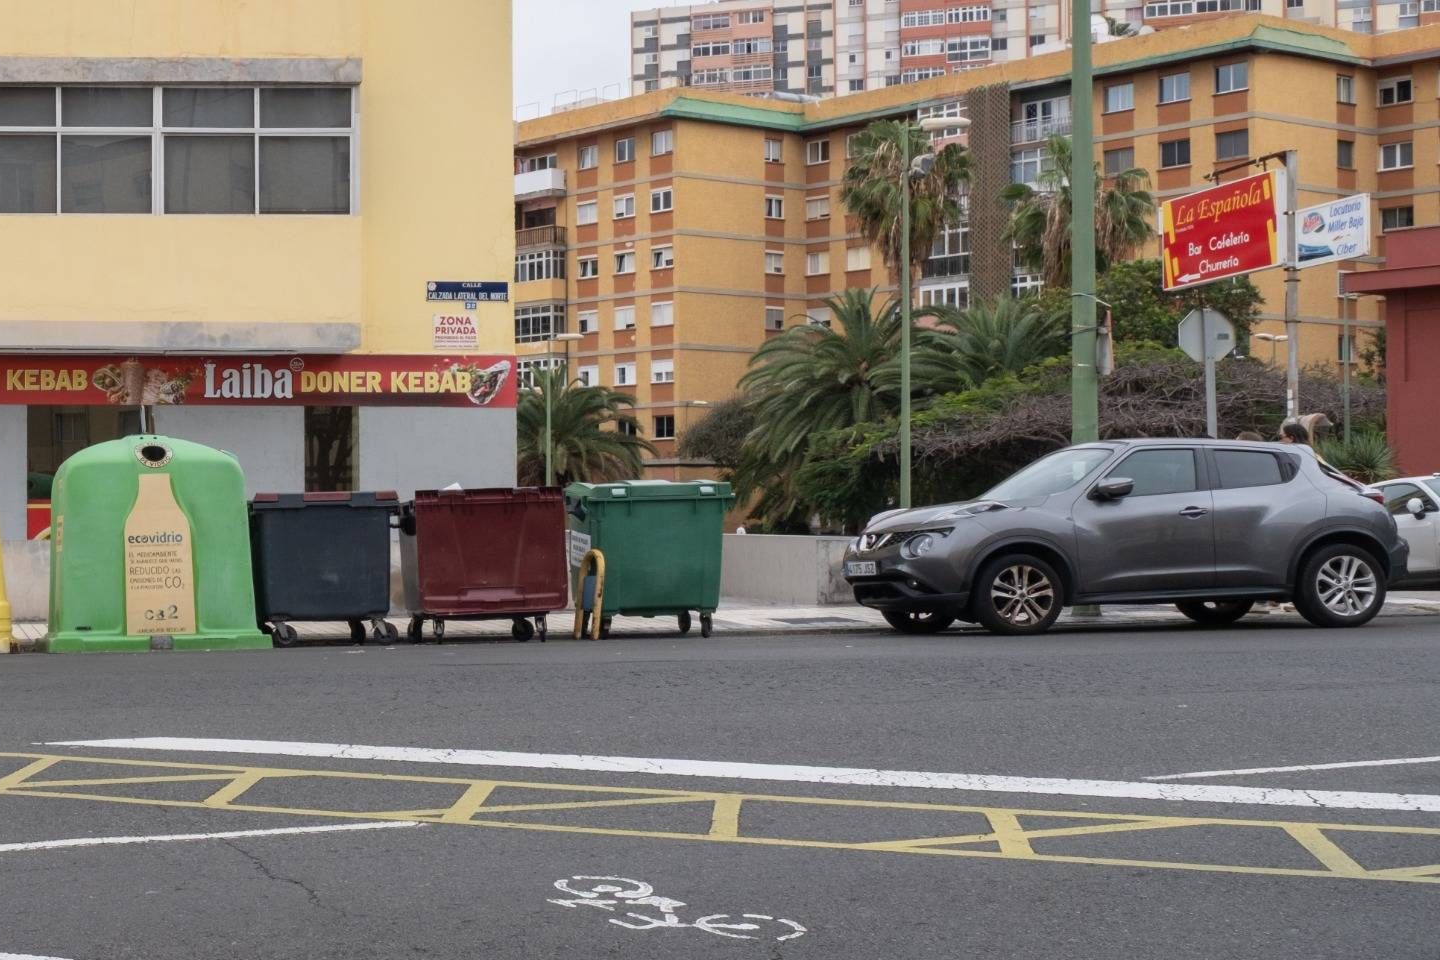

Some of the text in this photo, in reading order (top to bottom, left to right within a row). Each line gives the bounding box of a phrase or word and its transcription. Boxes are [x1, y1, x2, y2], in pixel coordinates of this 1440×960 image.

[1175, 181, 1261, 226] La Española
[1329, 201, 1361, 218] Locutorio
[1327, 219, 1347, 233] Miller
[1348, 216, 1364, 230] Bajo
[1188, 232, 1250, 257] Bar Cafetería
[1336, 243, 1358, 256] Ciber
[1198, 255, 1239, 274] Churrería
[428, 291, 507, 300] CALZADA LATERAL DEL NORTE
[439, 316, 472, 326] ZONA
[435, 326, 477, 335] PRIVADA
[6, 368, 88, 391] KEBAB
[204, 363, 294, 398] Laiba
[301, 371, 382, 393] DONER
[390, 371, 472, 393] KEBAB
[128, 531, 183, 544] ecovidrio
[129, 566, 170, 575] REDUCIDO
